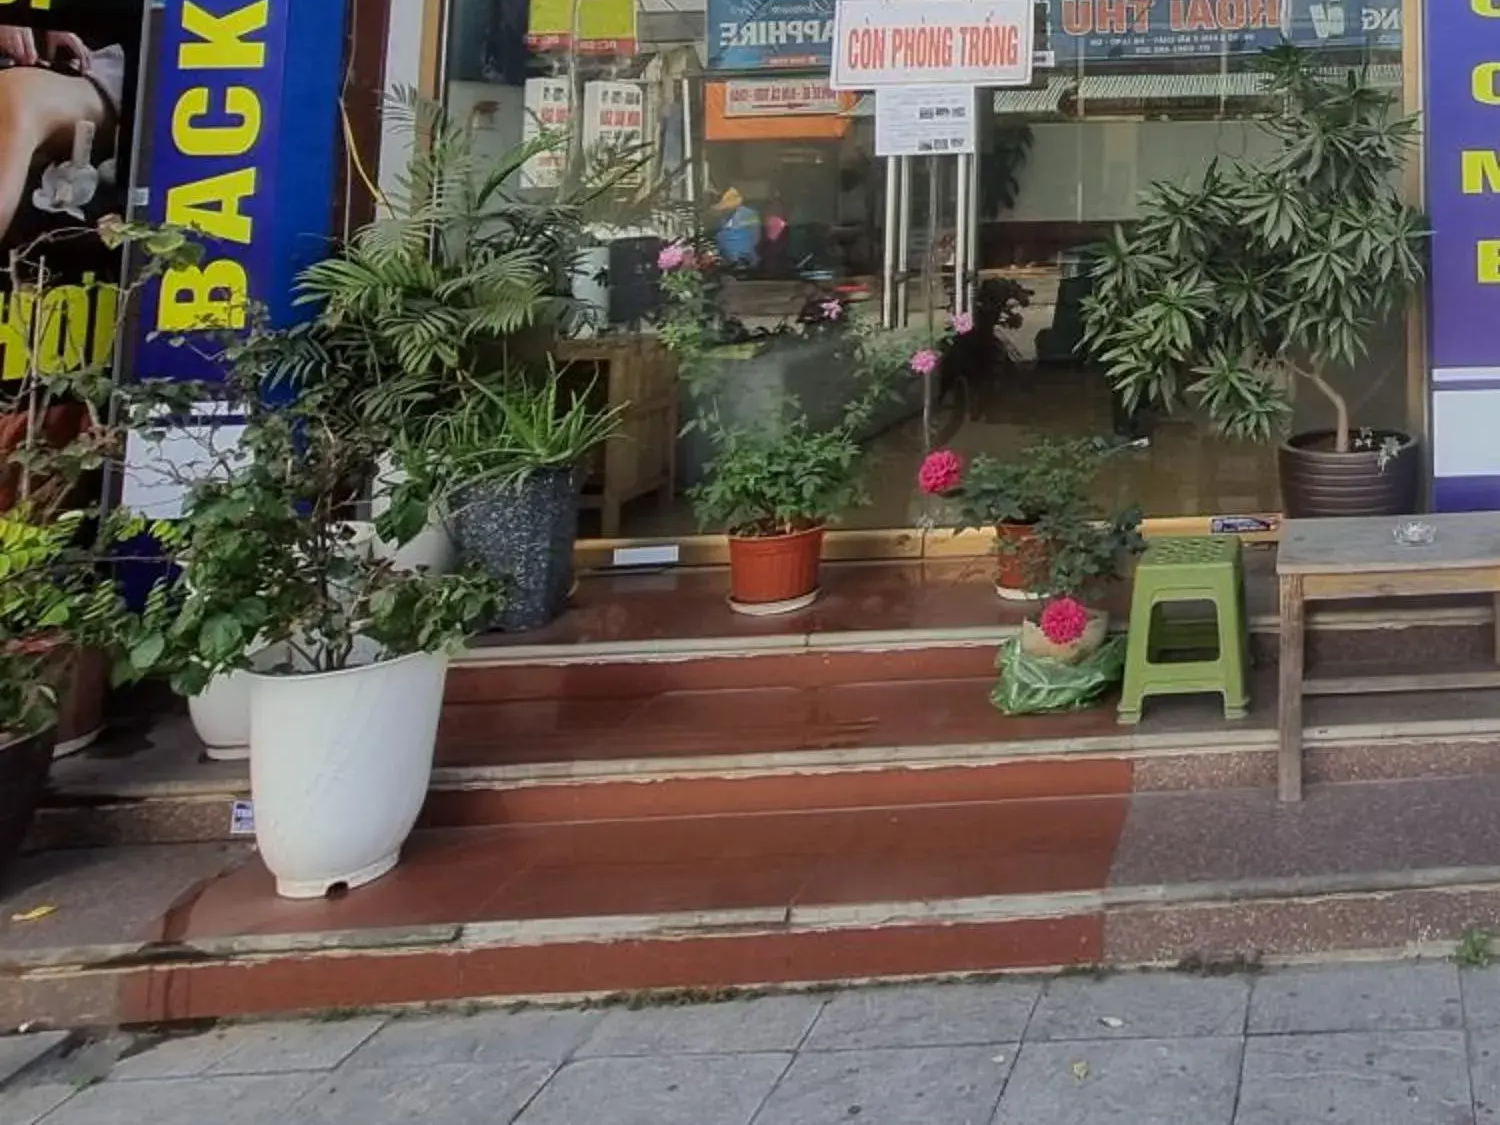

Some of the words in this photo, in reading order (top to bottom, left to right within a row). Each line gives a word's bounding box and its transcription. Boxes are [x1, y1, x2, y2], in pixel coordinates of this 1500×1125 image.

[848, 16, 885, 70] CÒN
[891, 15, 954, 69] PHÒNG
[959, 10, 1018, 67] TRỐNG
